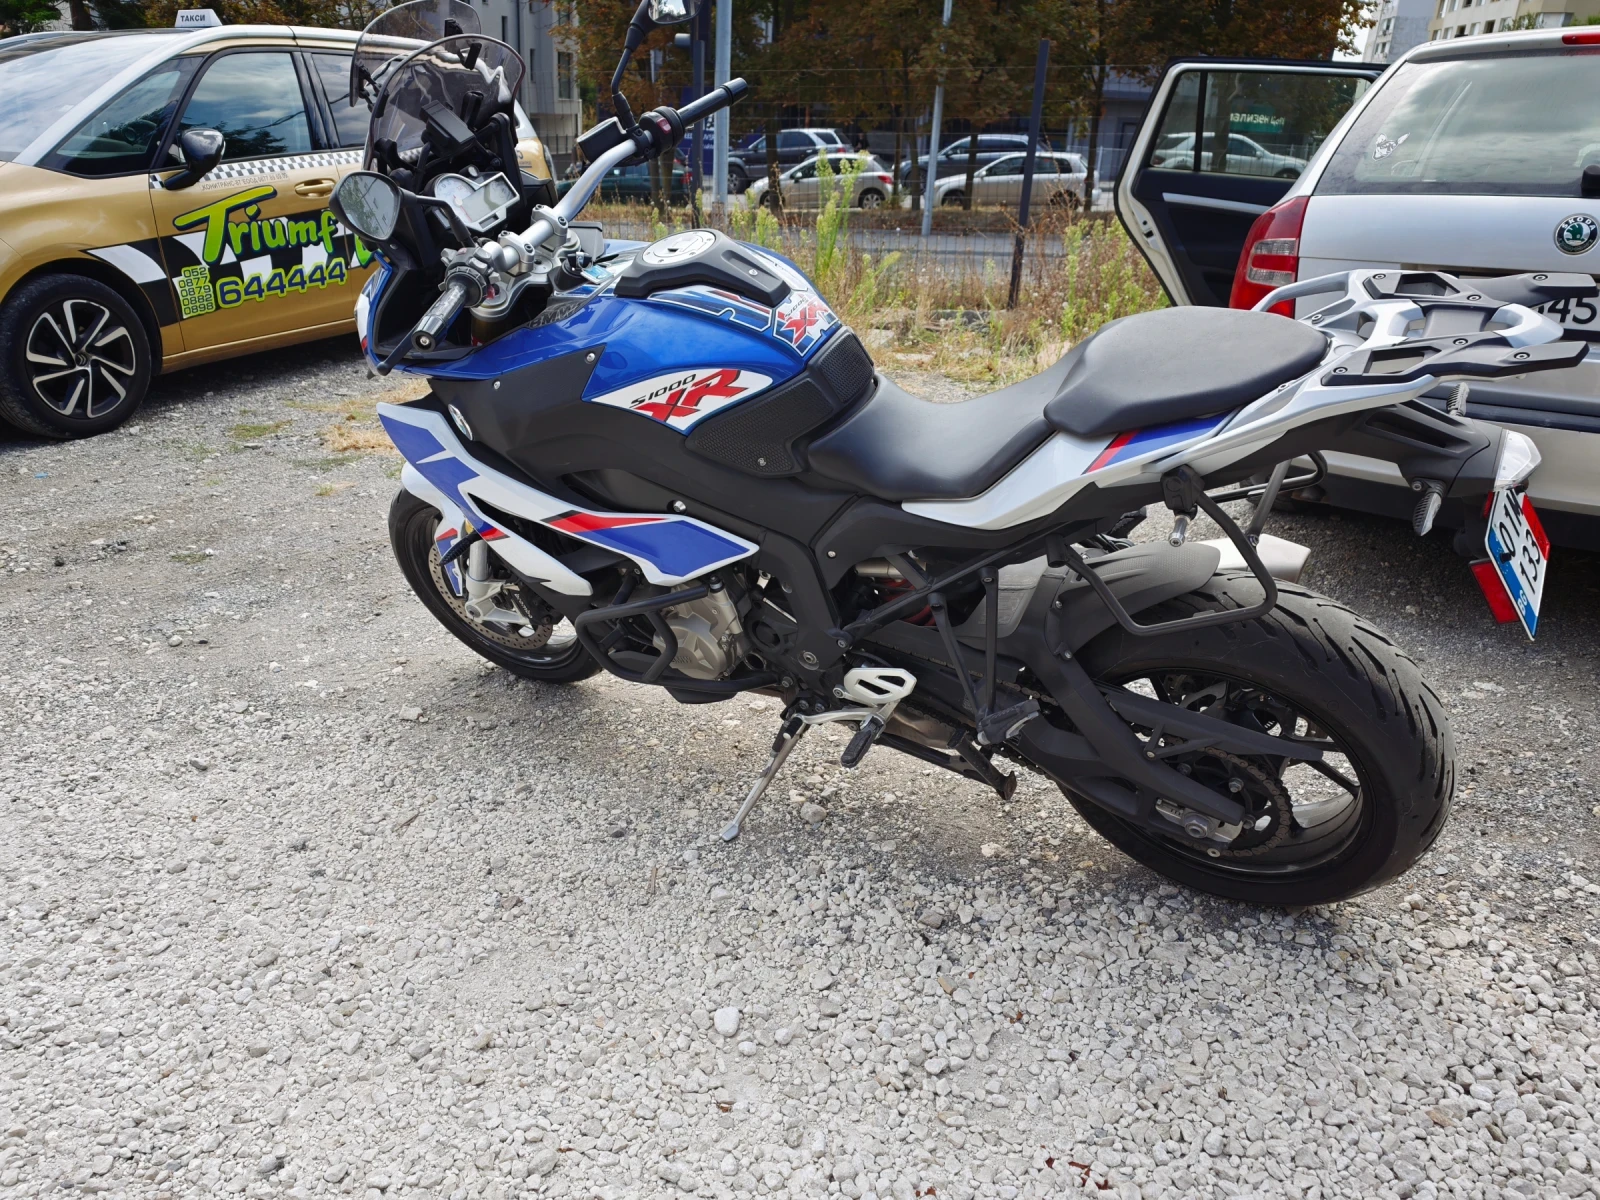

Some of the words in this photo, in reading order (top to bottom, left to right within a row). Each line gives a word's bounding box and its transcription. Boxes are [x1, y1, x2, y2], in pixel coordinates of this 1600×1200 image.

[180, 14, 206, 22] ТАКСИ
[173, 185, 338, 264] Triumf
[179, 276, 208, 289] 0877
[183, 266, 207, 278] 052
[180, 284, 212, 298] 0879
[219, 261, 346, 305] 644444
[182, 293, 213, 307] 0882
[183, 303, 214, 316] 0898
[629, 373, 696, 409] S1000
[633, 368, 749, 422] XR
[1519, 528, 1541, 595] 133
[1517, 589, 1528, 617] BG
